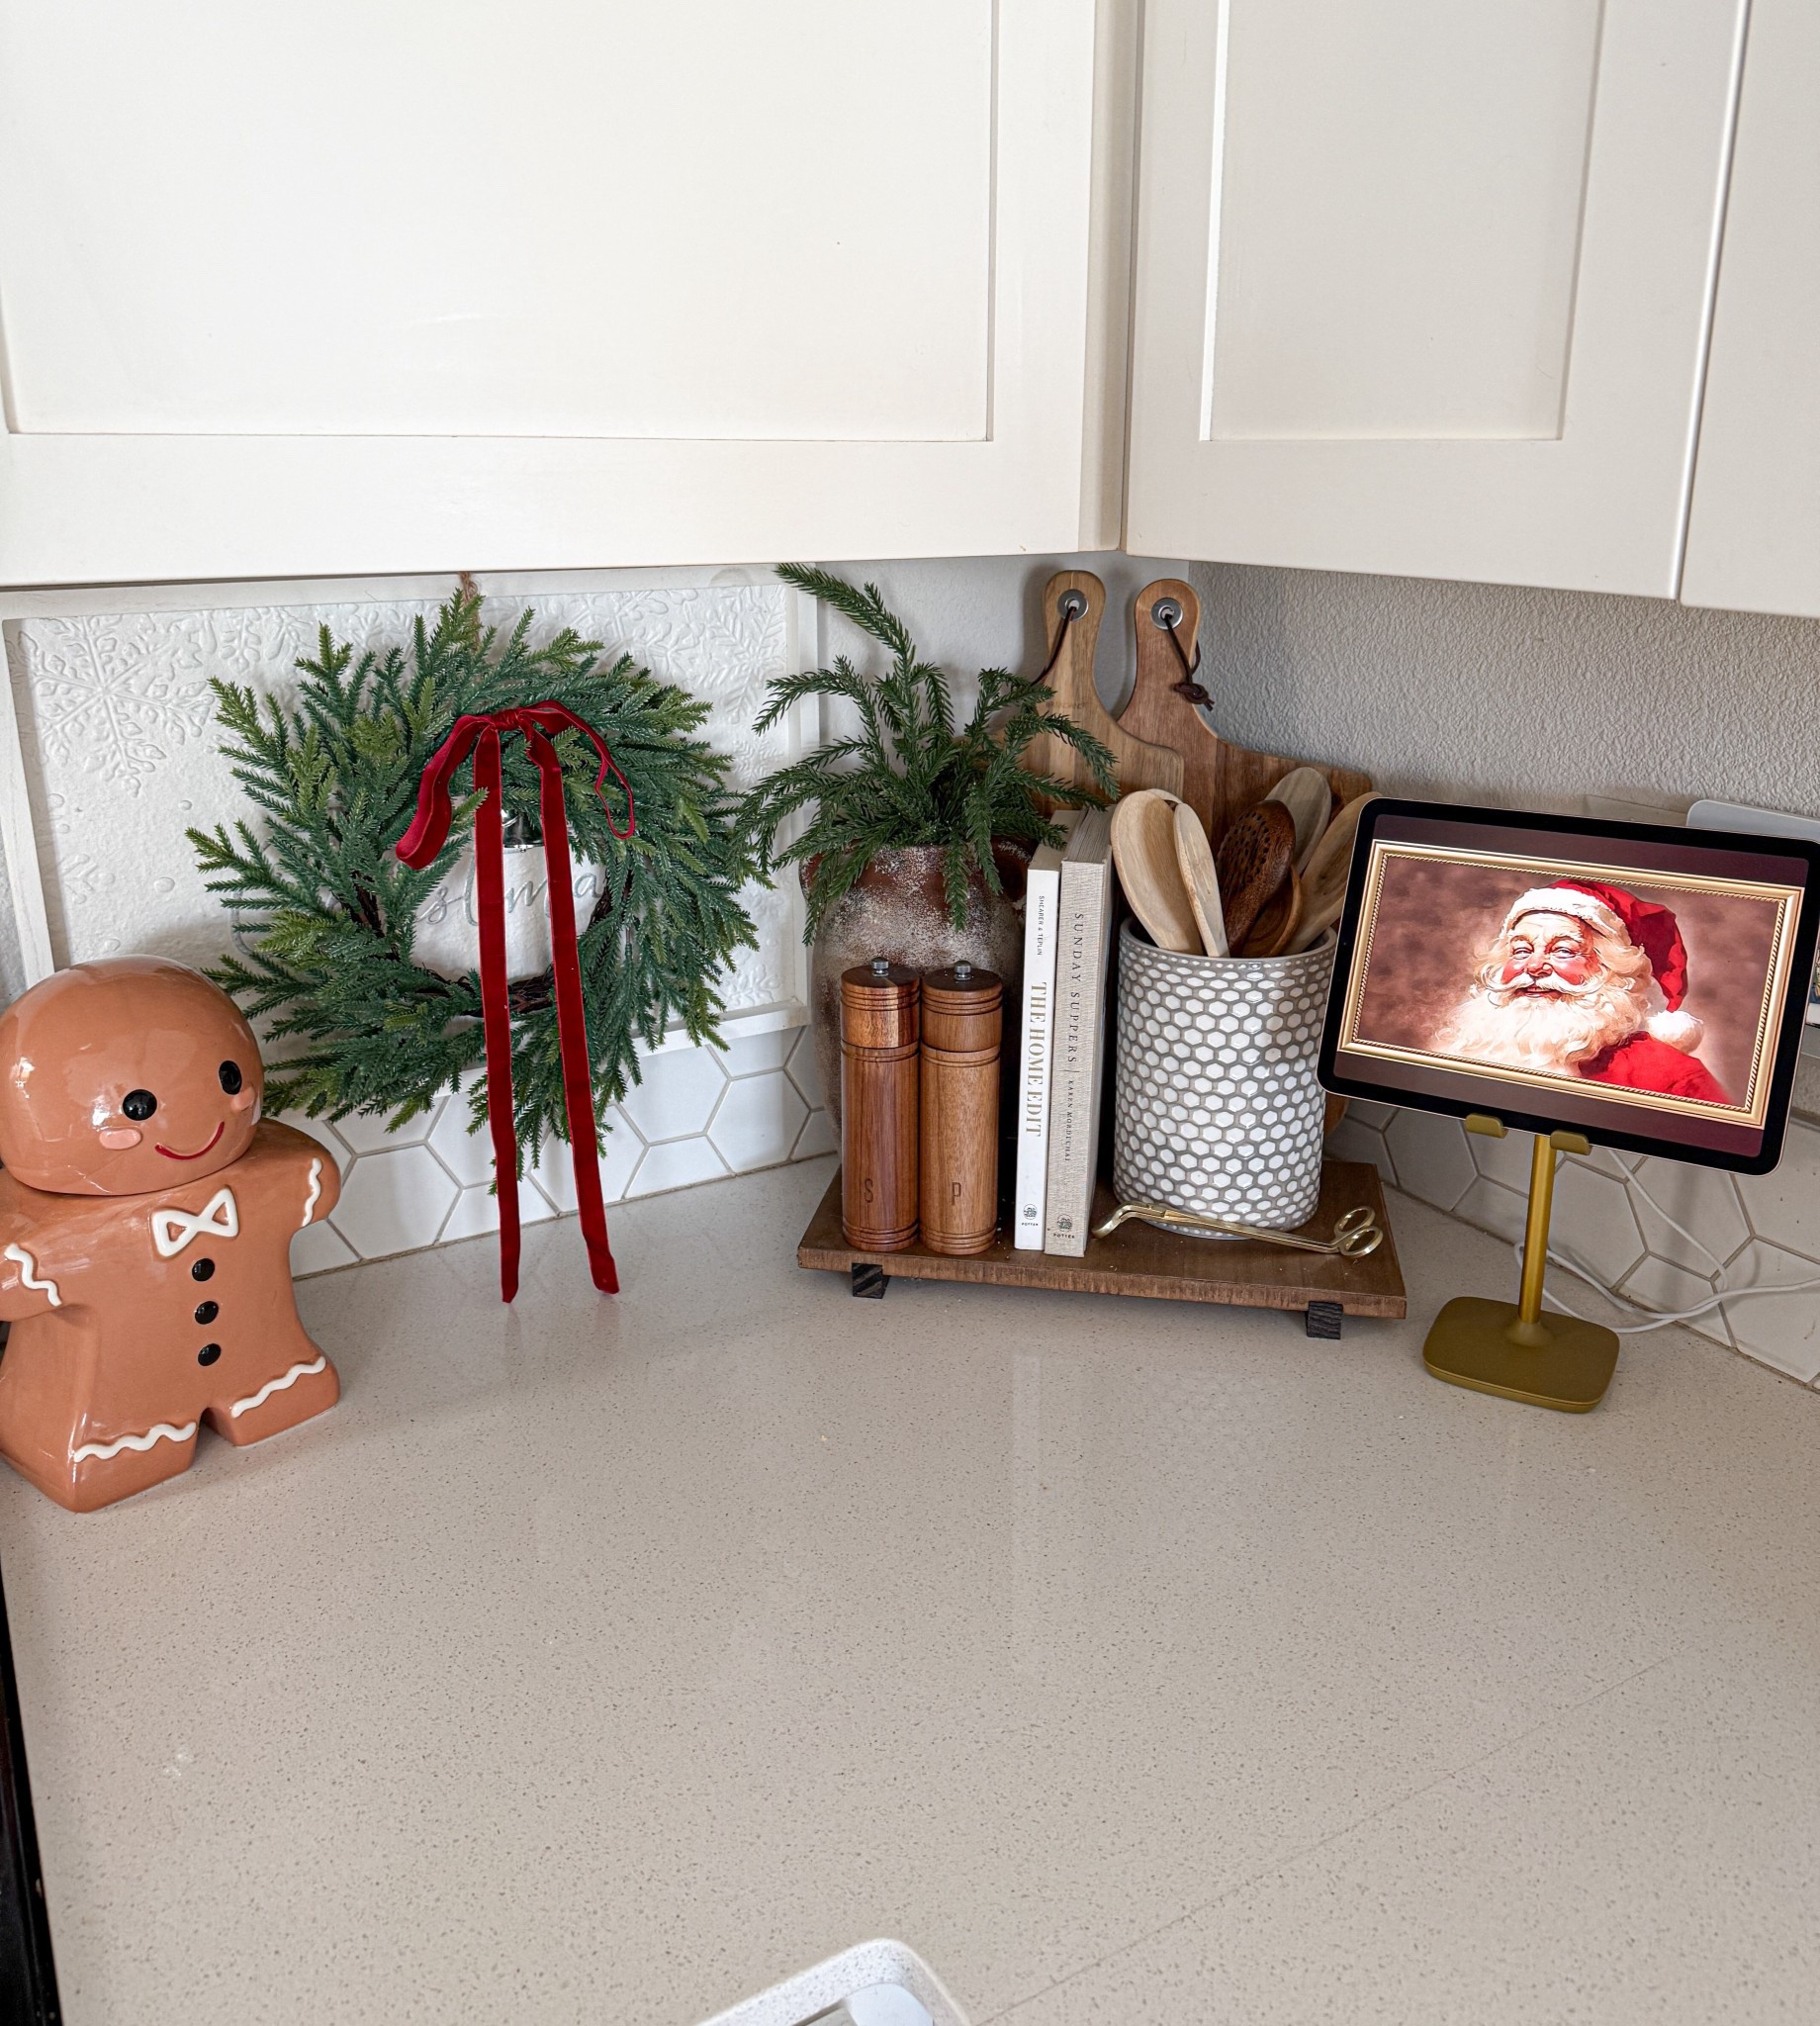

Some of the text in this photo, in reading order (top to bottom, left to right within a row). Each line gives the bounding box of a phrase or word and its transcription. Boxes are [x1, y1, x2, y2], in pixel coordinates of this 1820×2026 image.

[1068, 913, 1084, 1062] SUNDAY SUPPERS
[1026, 981, 1047, 1137] THE HOME EDIT
[864, 1177, 874, 1204] S
[951, 1181, 962, 1206] P
